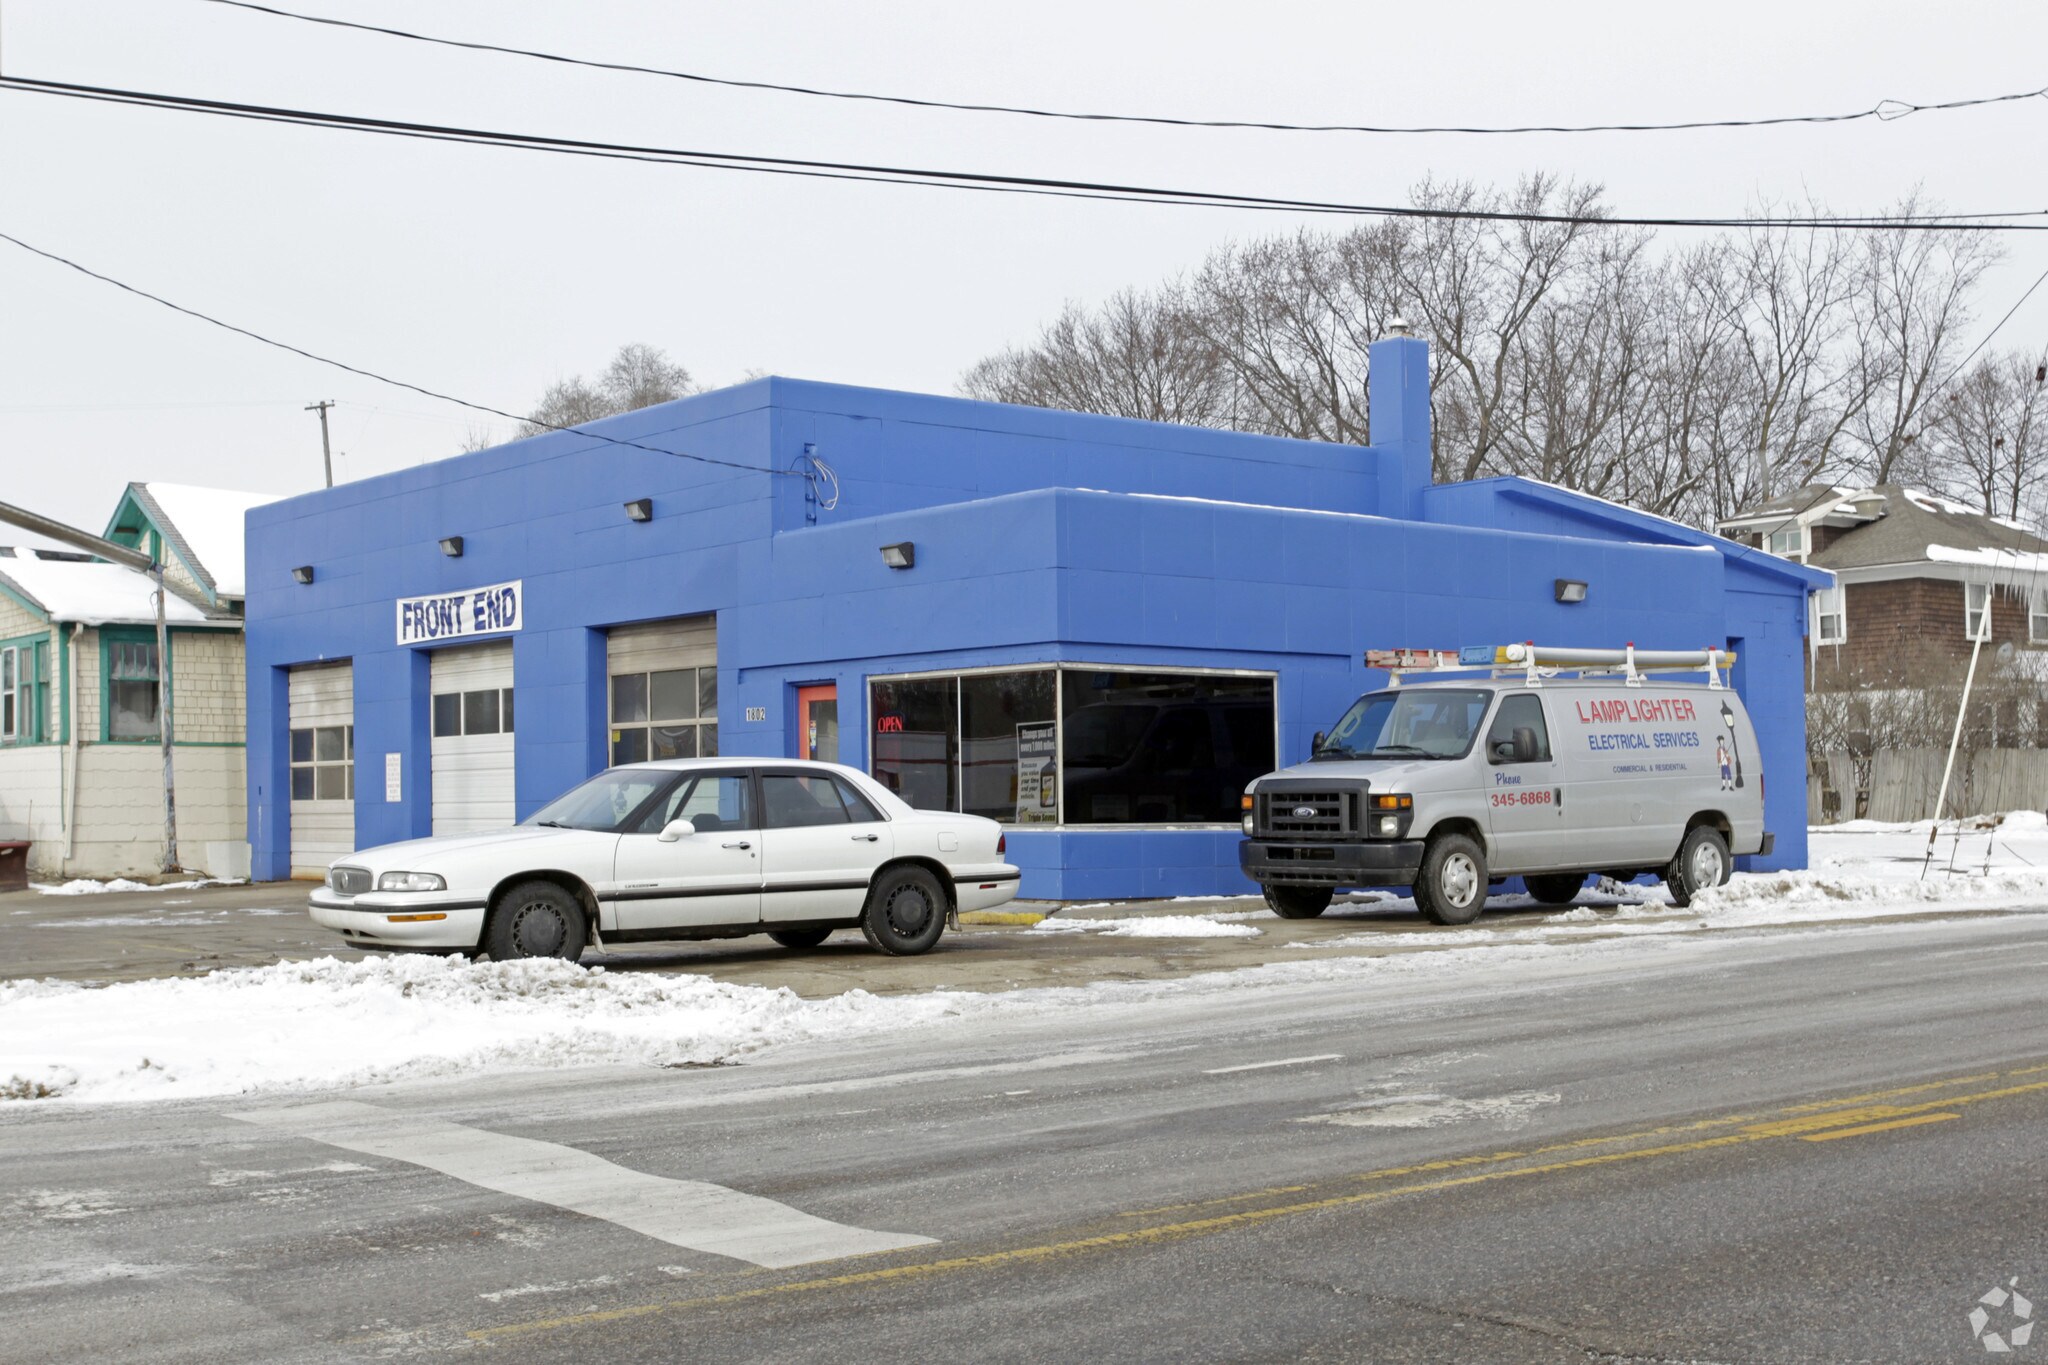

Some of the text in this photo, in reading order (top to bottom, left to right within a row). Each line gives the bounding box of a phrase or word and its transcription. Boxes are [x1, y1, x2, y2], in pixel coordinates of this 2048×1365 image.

[402, 587, 516, 640] FRONT END
[747, 708, 765, 721] 1802
[1575, 699, 1697, 724] LAMPLIGHTER
[877, 715, 903, 733] OPEN
[1588, 732, 1699, 750] ELECTRICAL SERVICES
[1612, 764, 1647, 773] COMMERCIAL
[1655, 763, 1687, 771] RESIDENTIAL
[1495, 772, 1521, 786] Phone
[1491, 791, 1551, 807] 345-6868
